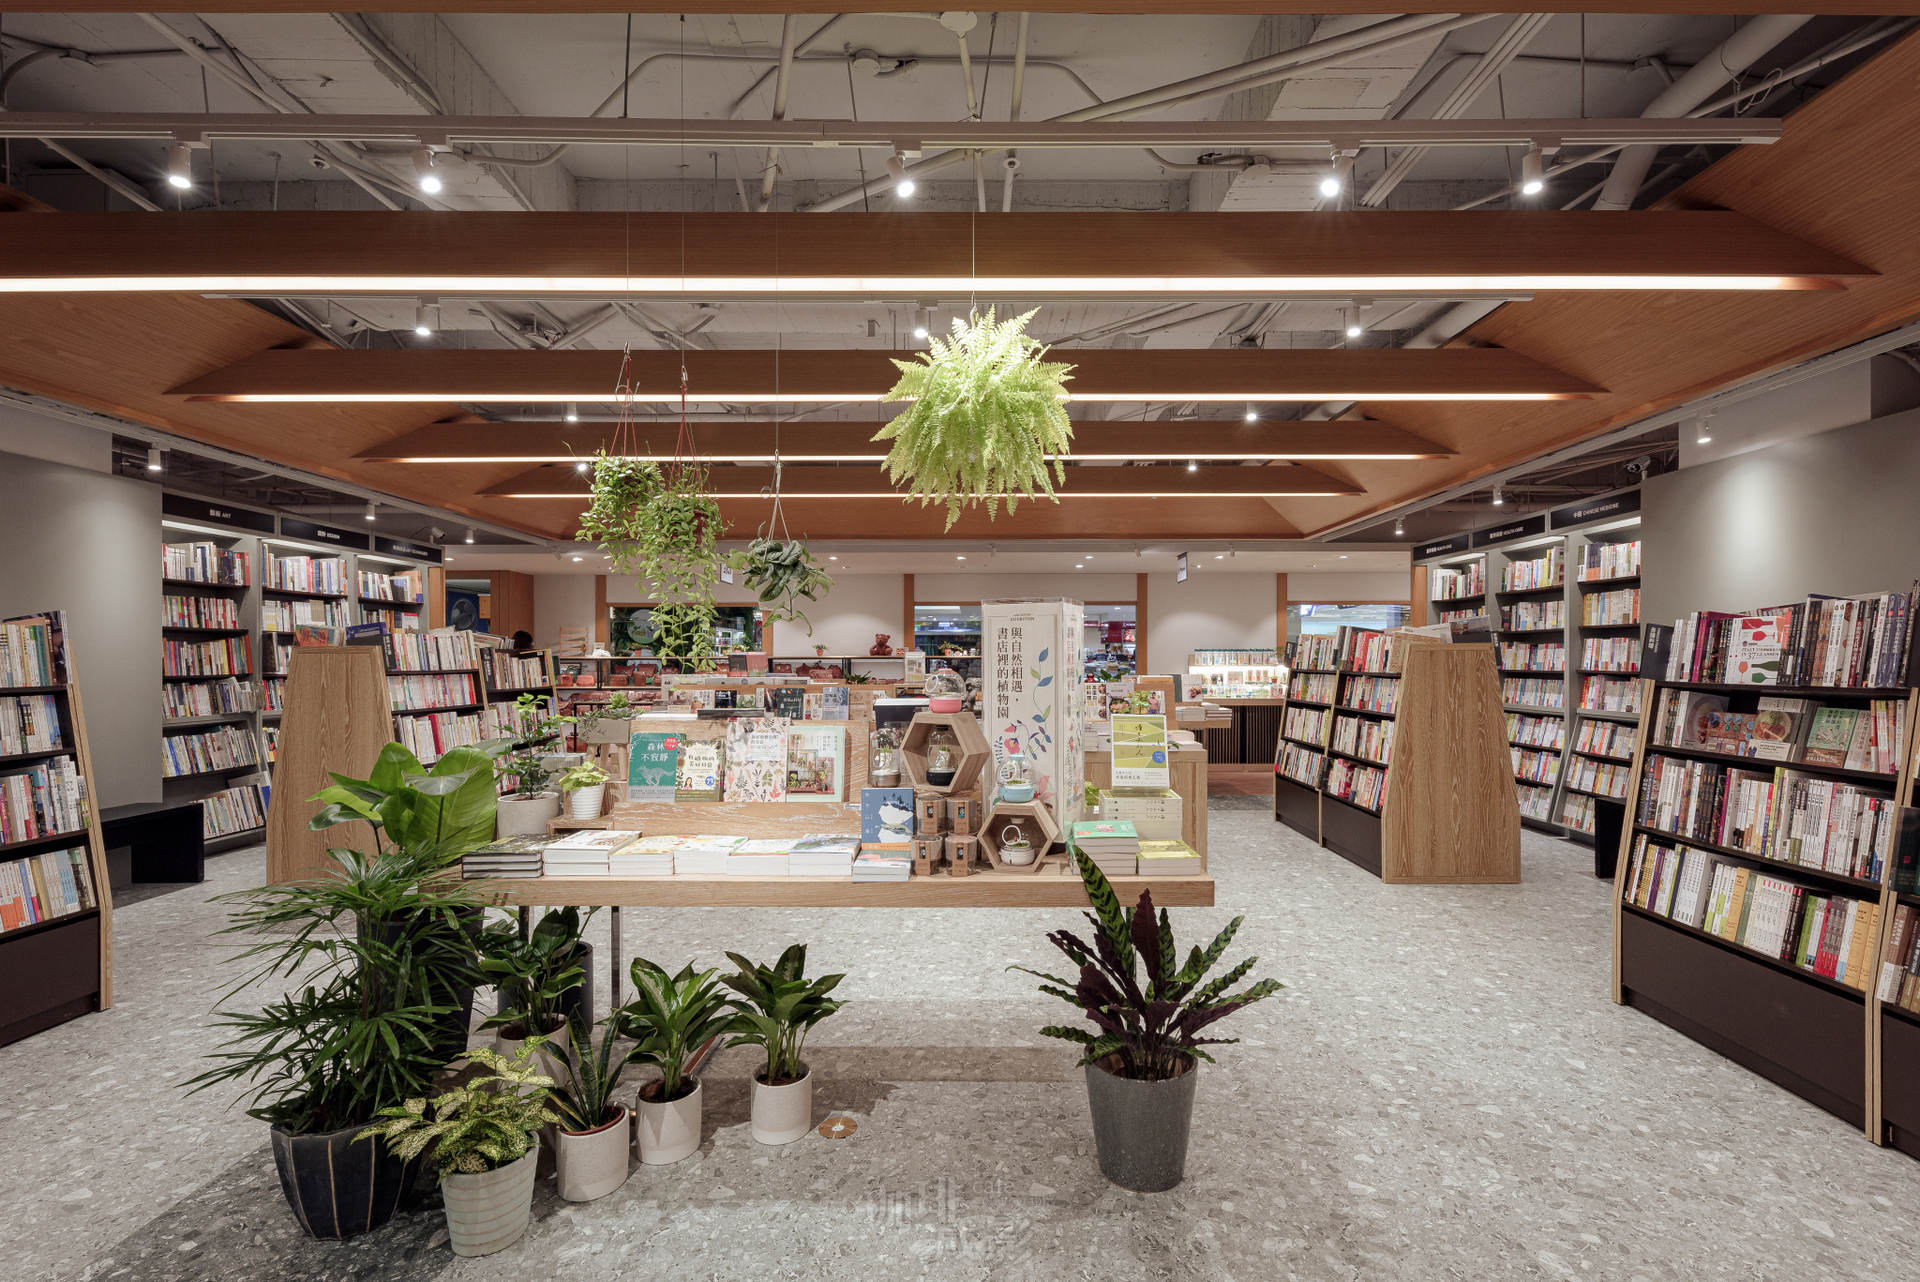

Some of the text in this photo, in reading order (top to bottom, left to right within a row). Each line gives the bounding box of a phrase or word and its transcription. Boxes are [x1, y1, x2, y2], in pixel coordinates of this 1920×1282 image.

[997, 627, 1009, 719] 書店裡的植物園
[641, 753, 669, 762] 不寂靜
